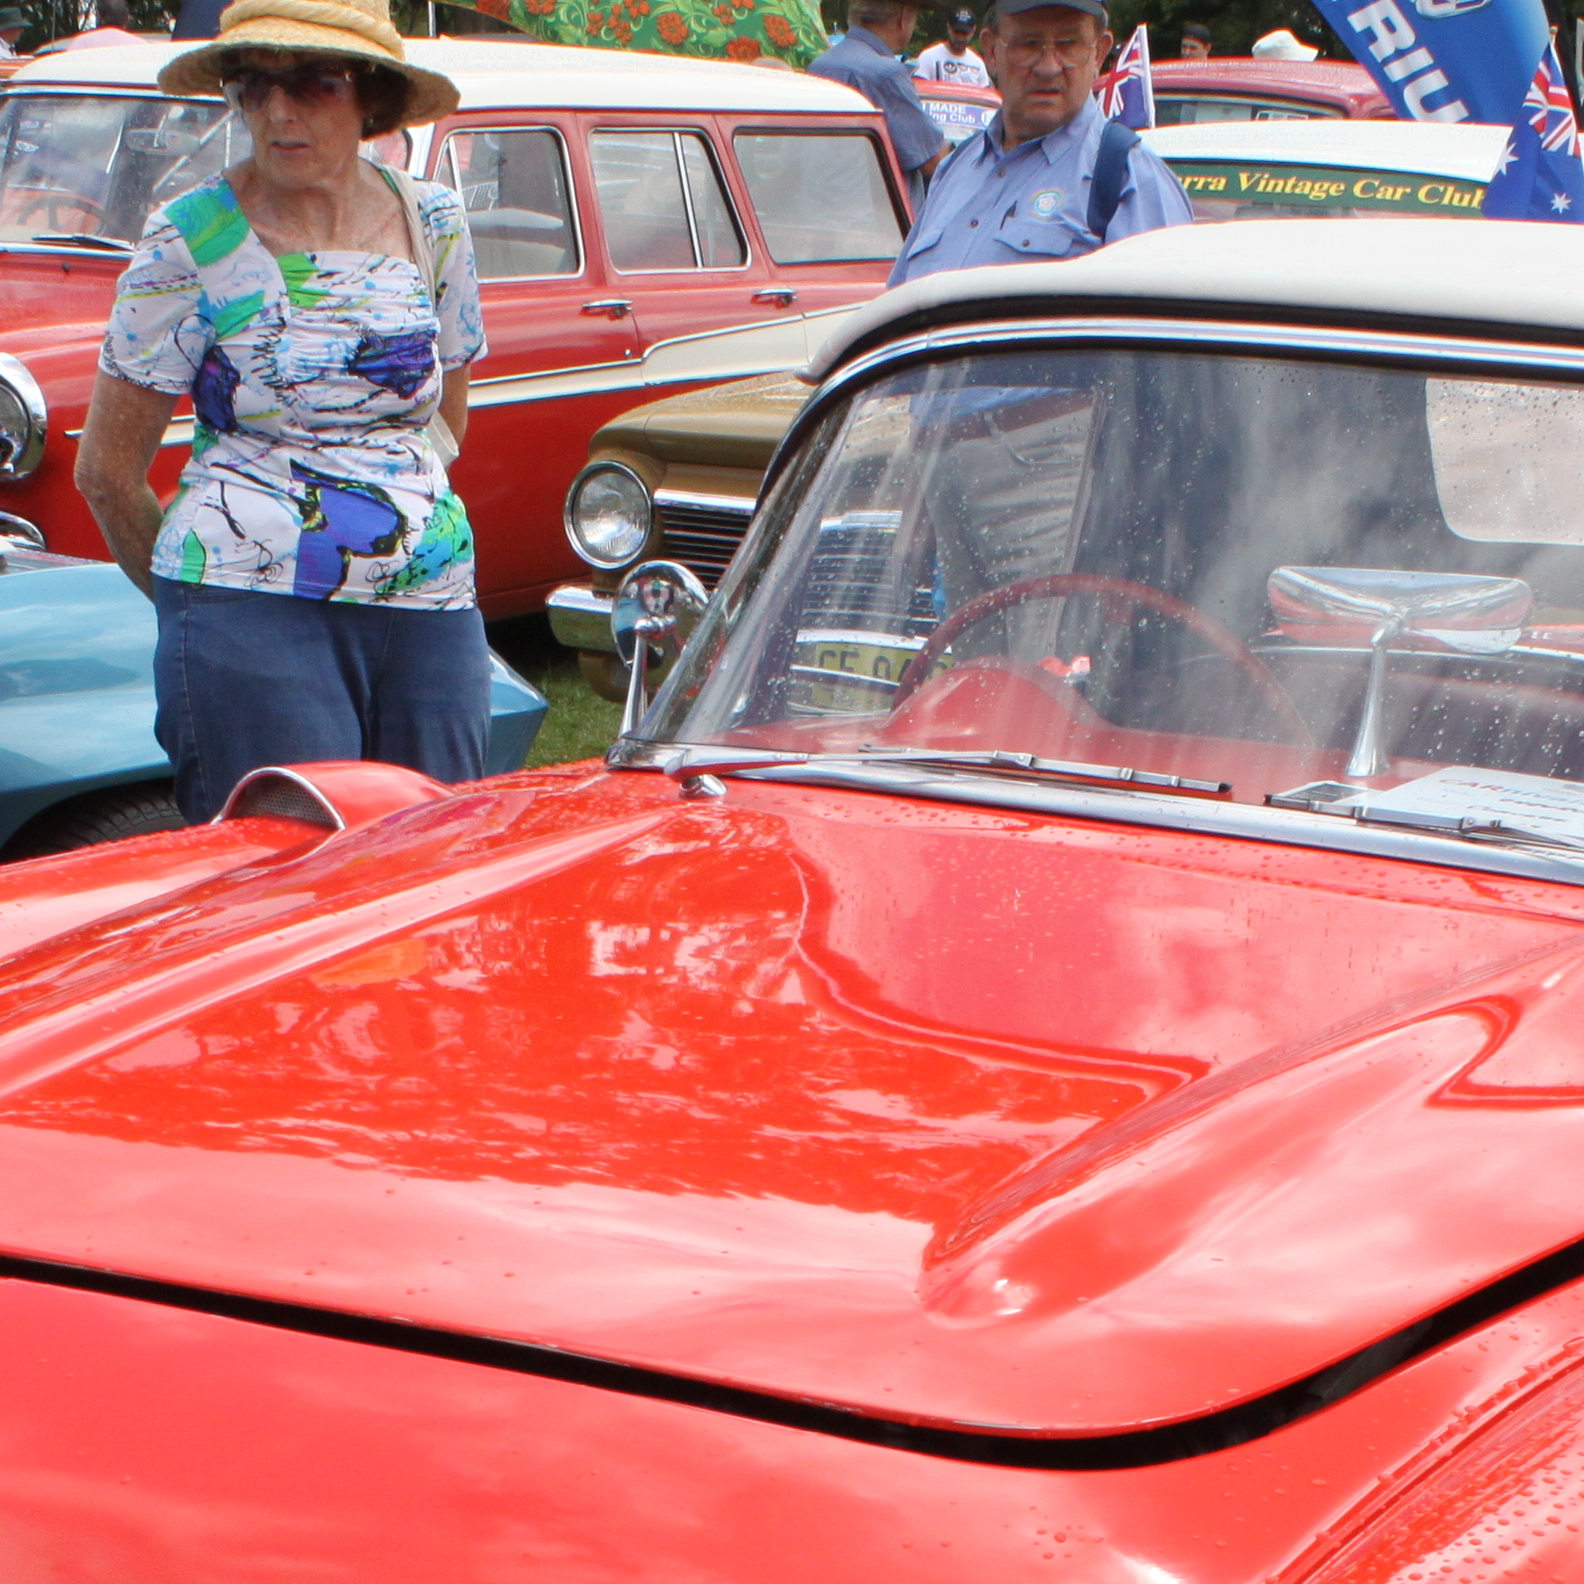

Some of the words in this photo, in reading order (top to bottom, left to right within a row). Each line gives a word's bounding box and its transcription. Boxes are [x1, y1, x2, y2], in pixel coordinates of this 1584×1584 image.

[949, 112, 976, 124] Club
[1238, 171, 1346, 201] Vintage
[1353, 178, 1411, 202] Car
